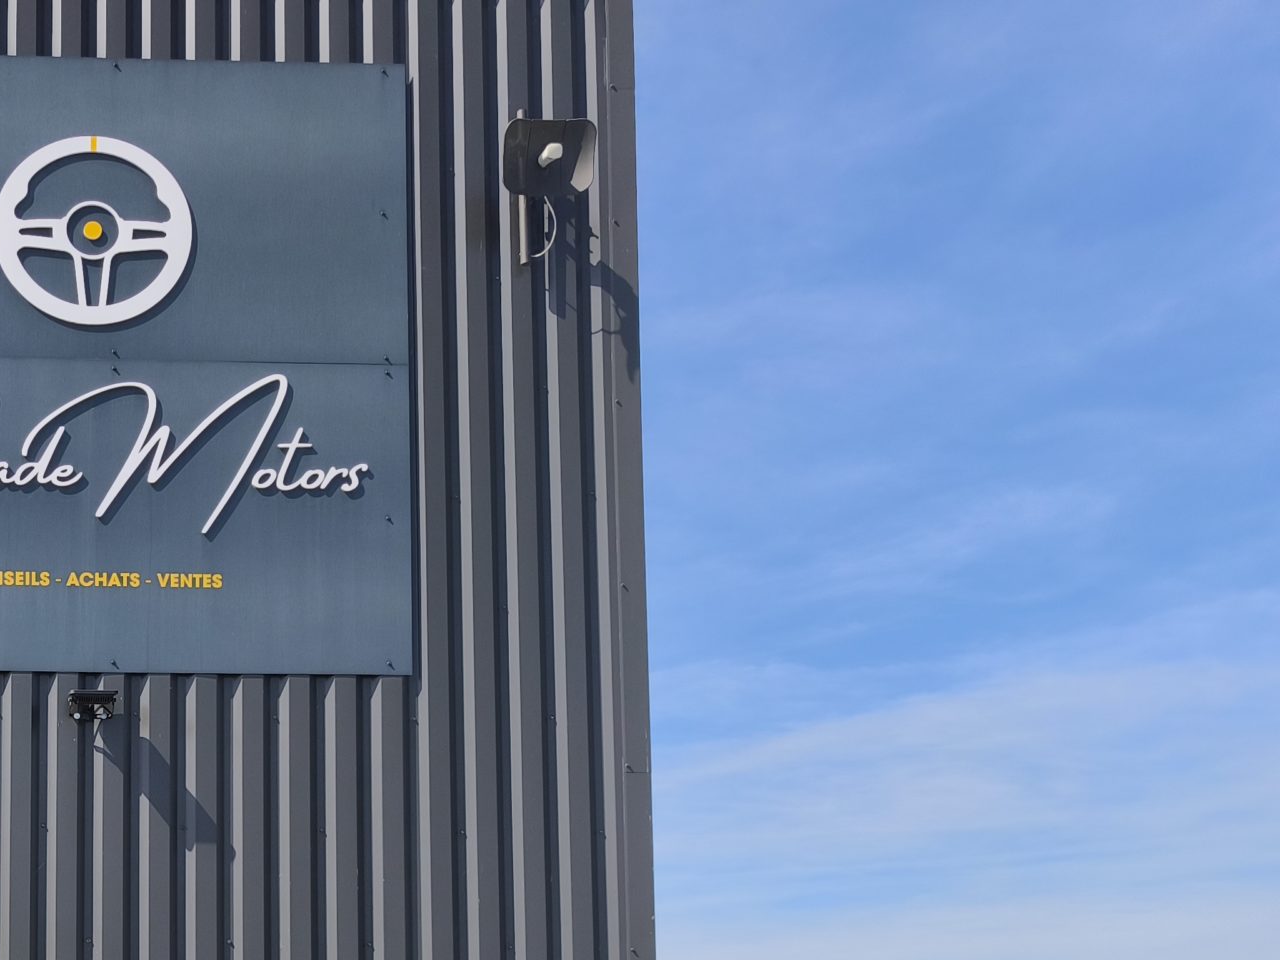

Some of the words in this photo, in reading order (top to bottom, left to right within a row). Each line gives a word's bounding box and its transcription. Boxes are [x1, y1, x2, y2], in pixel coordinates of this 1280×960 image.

[21, 372, 370, 536] Motors
[66, 572, 141, 588] ACHATS
[157, 573, 223, 589] VENTES
